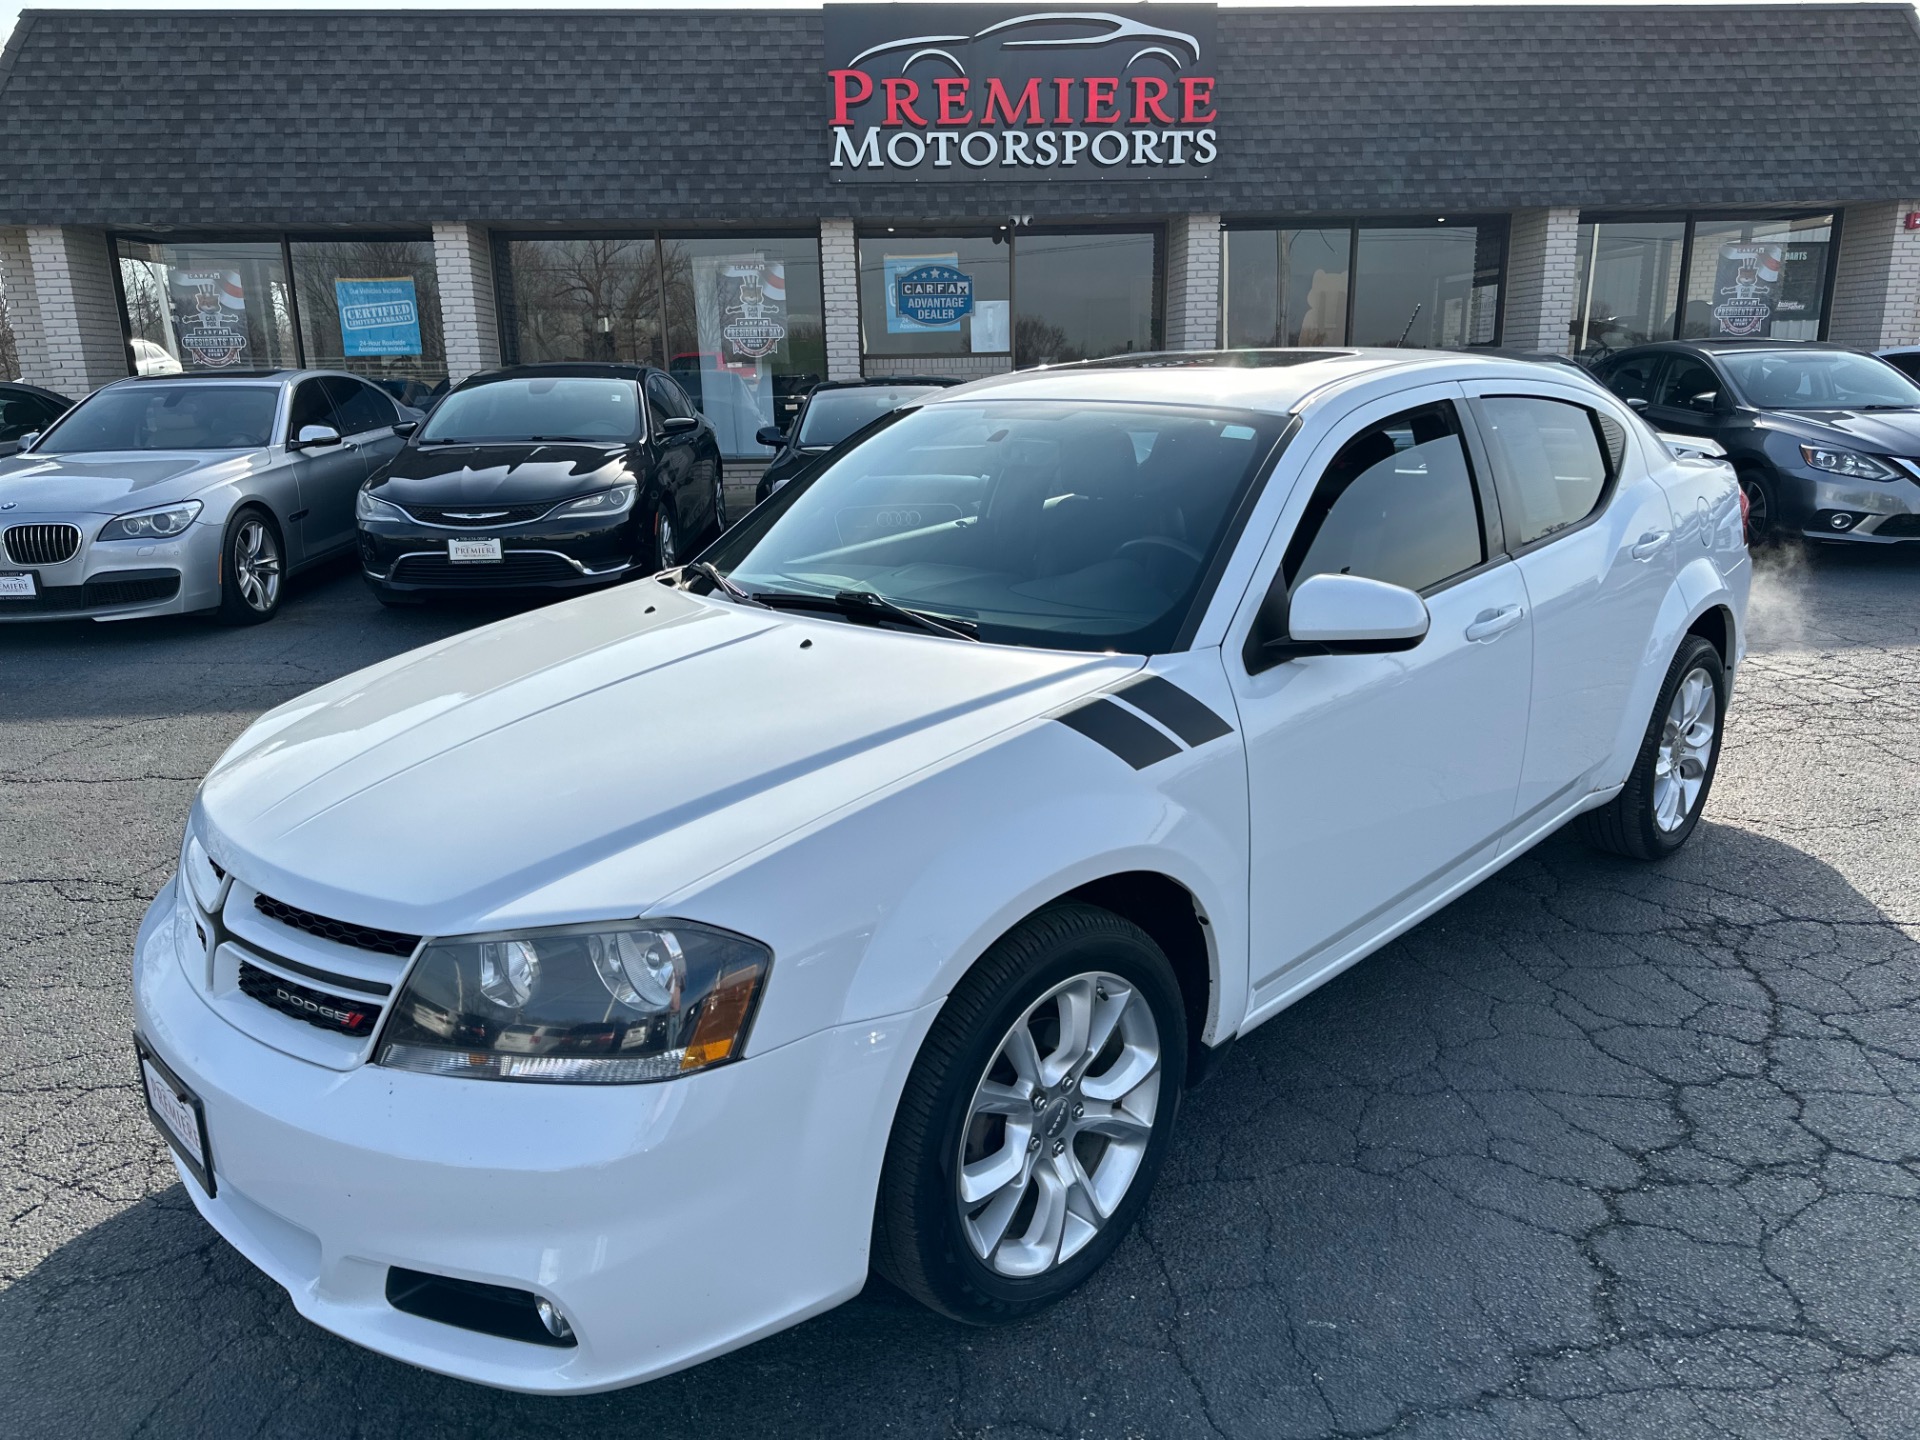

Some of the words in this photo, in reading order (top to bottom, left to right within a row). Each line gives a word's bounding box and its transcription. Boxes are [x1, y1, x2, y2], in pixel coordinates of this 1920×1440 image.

[828, 69, 1217, 126] PREMIERE
[829, 126, 1217, 168] MOTORSPORTS
[902, 283, 969, 295] CARFAX
[908, 298, 964, 308] ADVANTAGE
[347, 304, 410, 320] CERTIFIED
[918, 309, 955, 319] DEALER
[276, 988, 350, 1023] DODGE
